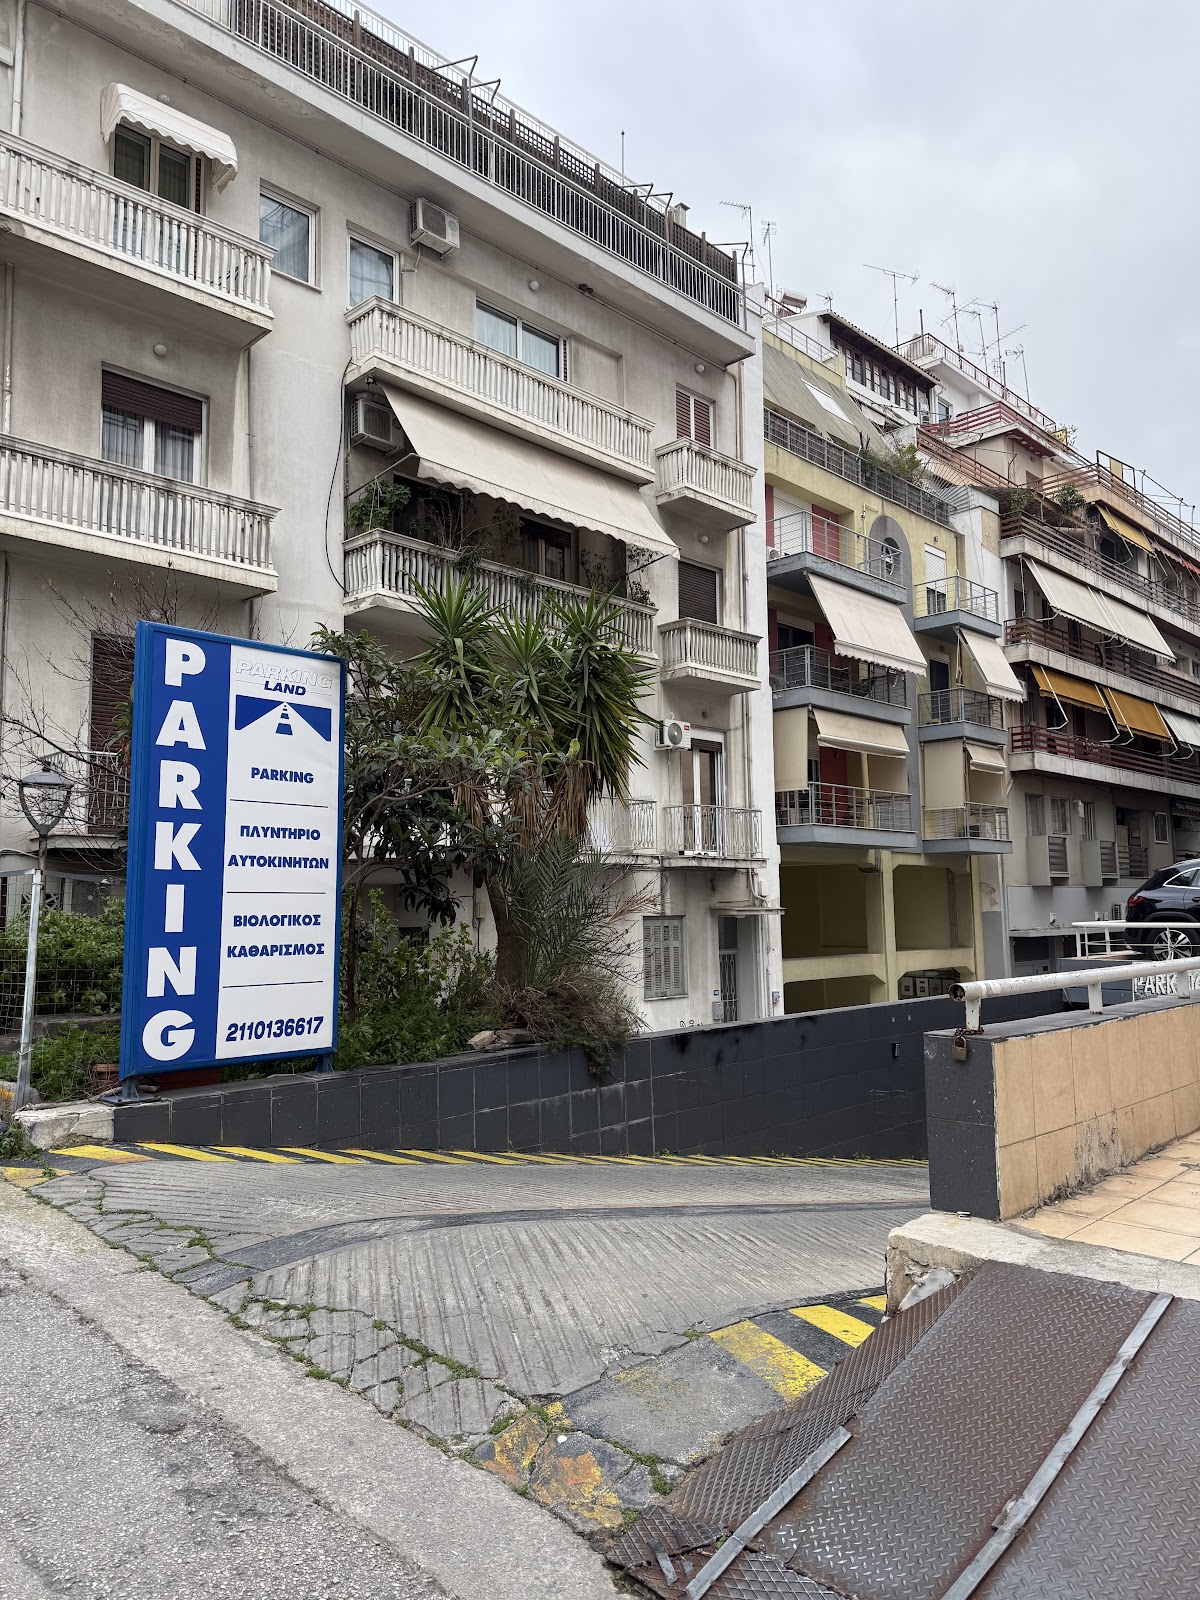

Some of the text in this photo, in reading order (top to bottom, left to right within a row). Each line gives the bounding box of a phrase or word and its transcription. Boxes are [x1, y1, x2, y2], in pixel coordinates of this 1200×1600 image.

[235, 659, 333, 689] PARKING
[264, 681, 306, 696] LAND
[251, 767, 314, 784] PARKING
[240, 825, 321, 841] ΠΛΥΝΤΗΡΙΟ
[142, 638, 207, 1061] PARKING
[228, 855, 329, 869] ΑΥΤΟΚΙΝΗΤΩΝ
[233, 914, 321, 927] ΒΙΟΛΟΓΙΚΟΣ
[227, 943, 325, 958] ΚΑΘΑΡΙΣΜΟΣ
[225, 1016, 324, 1042] 2110136617
